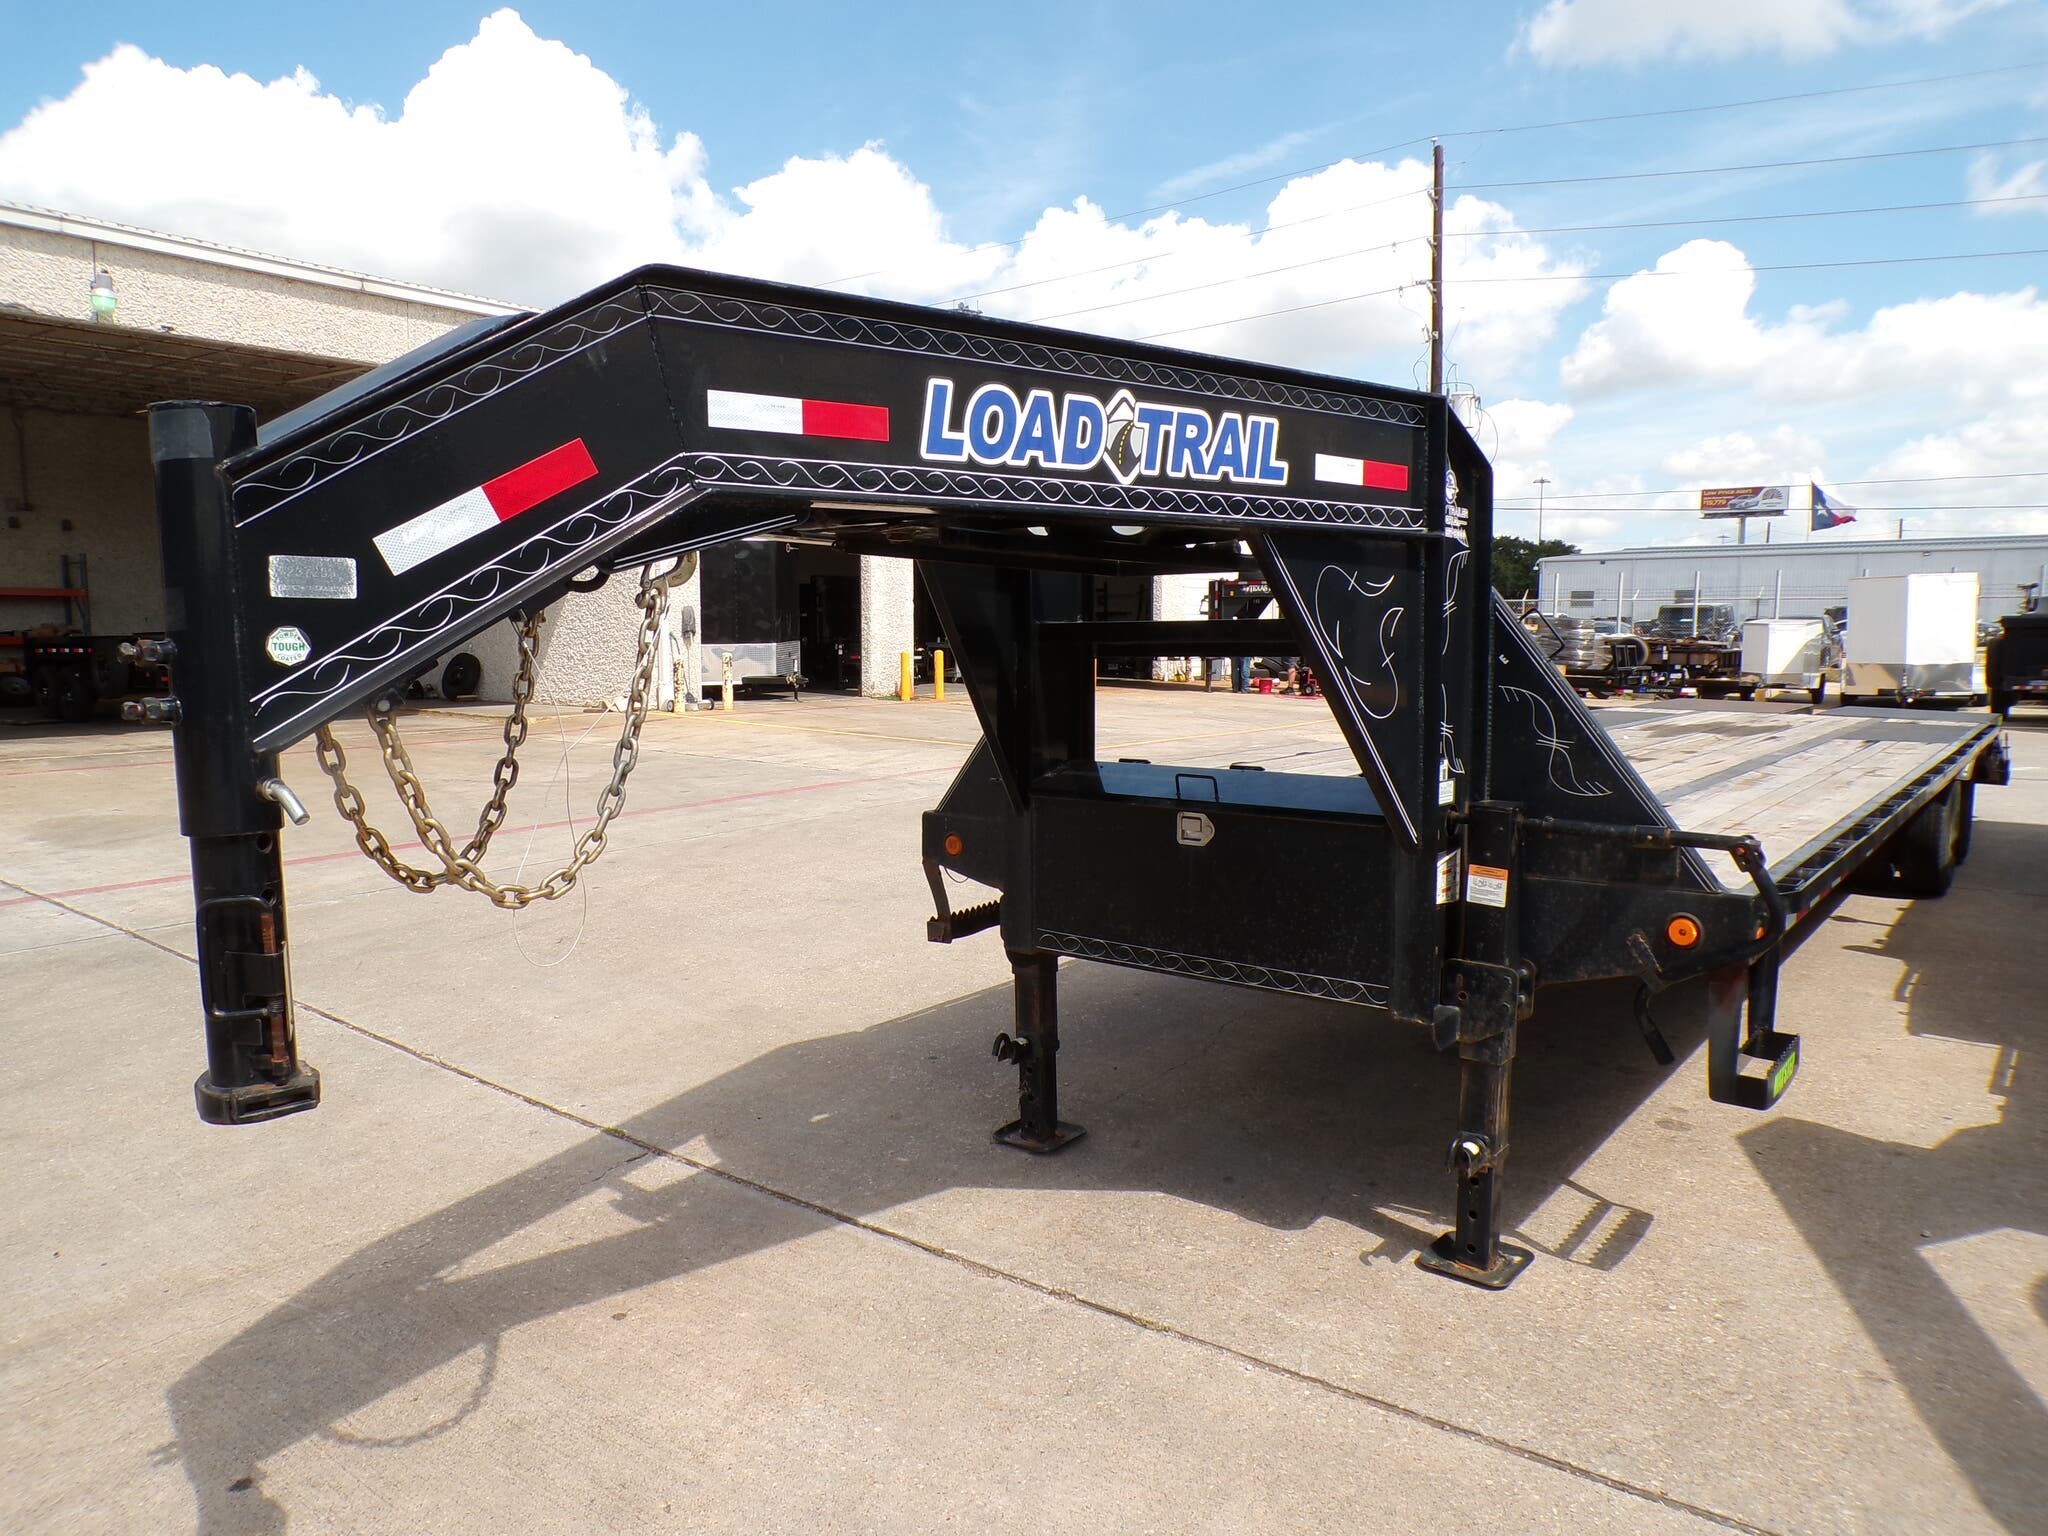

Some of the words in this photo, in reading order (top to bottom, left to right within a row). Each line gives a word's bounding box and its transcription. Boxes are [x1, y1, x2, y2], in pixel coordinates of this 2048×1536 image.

[921, 377, 1107, 471] LOAD
[1134, 402, 1289, 486] TRAIL
[273, 643, 305, 651] TOUGH
